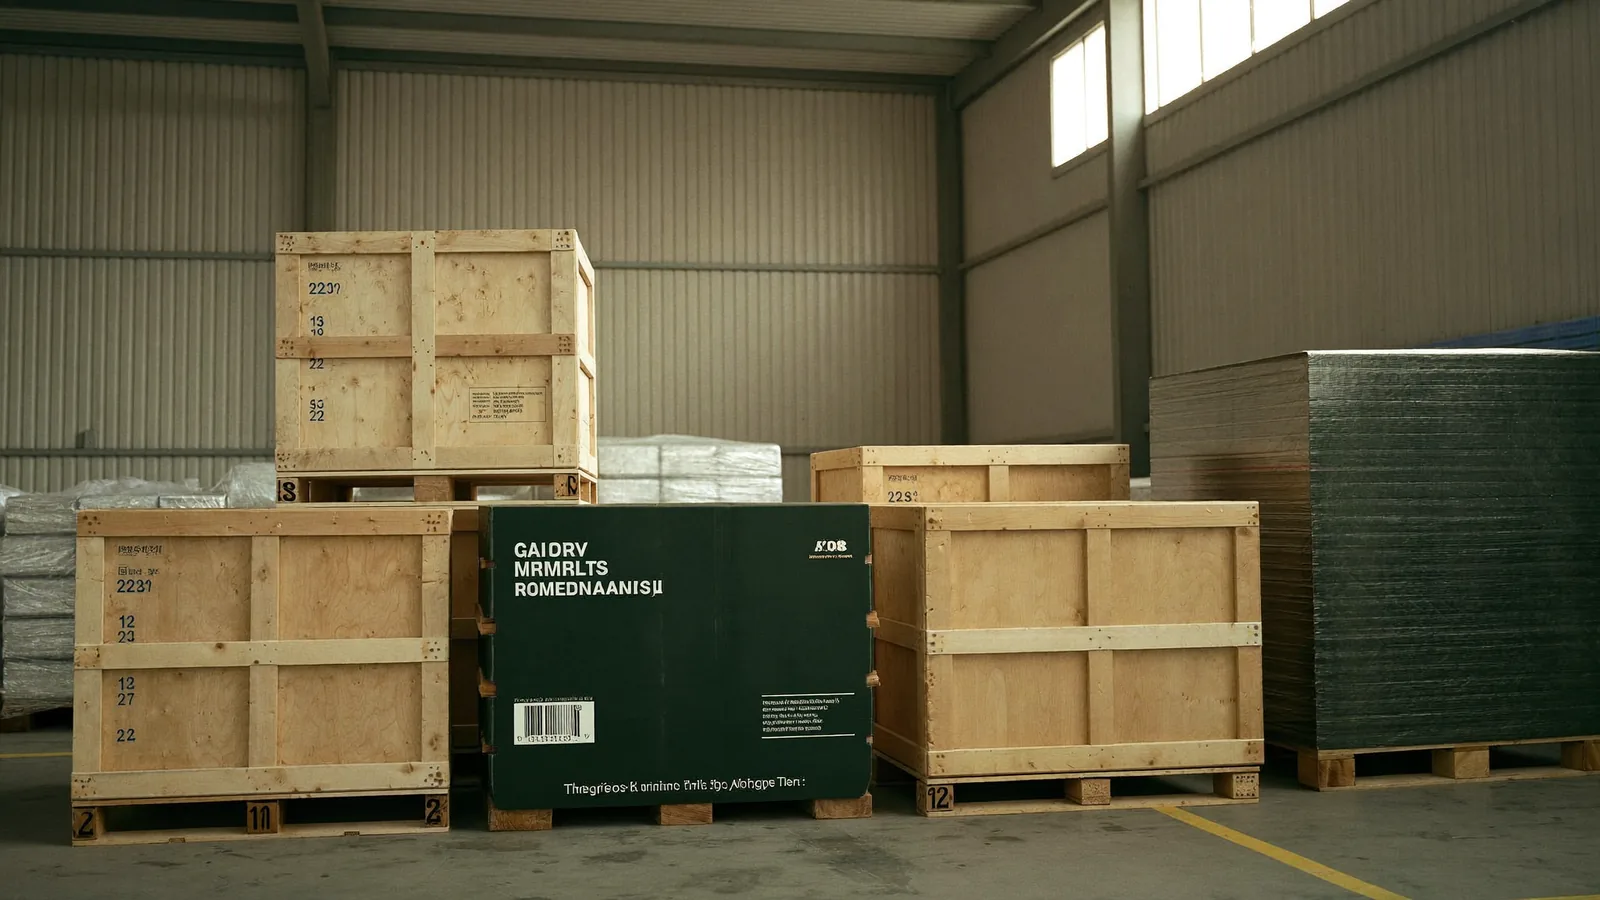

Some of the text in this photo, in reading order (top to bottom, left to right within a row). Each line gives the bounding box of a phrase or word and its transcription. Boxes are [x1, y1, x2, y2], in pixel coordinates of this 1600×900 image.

[309, 410, 324, 421] 22
[514, 560, 608, 577] MRMRLTS
[119, 615, 135, 628] 12
[118, 676, 135, 690] 12
[118, 693, 134, 705] 27
[117, 728, 136, 742] 22
[928, 786, 949, 809] 12
